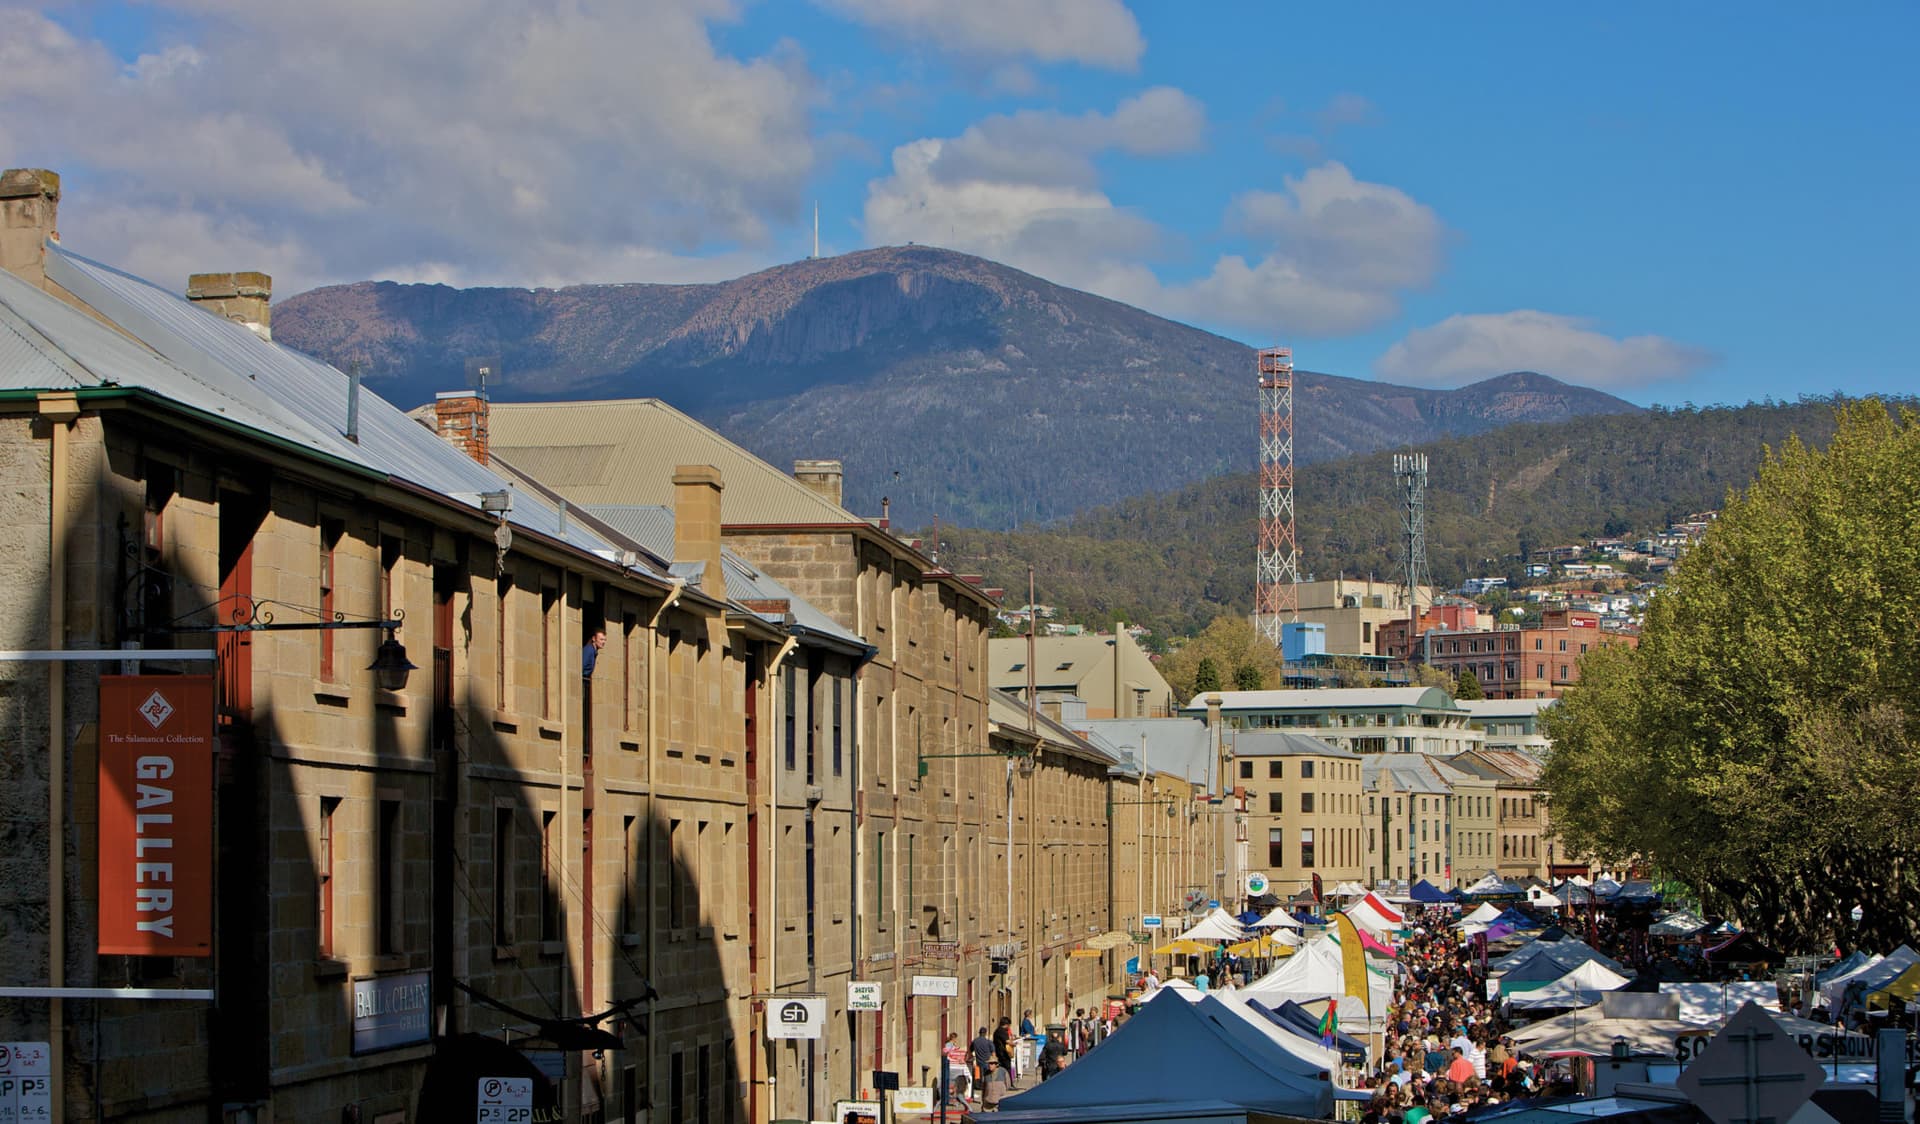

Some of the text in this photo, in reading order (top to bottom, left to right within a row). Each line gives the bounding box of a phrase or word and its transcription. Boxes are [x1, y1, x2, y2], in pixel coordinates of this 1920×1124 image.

[109, 734, 204, 743] The Salamanca Collection
[136, 755, 174, 939] GALLERY
[915, 981, 956, 989] ASPECT
[356, 988, 384, 1018] BALL
[392, 983, 427, 1013] CHAIN
[508, 1109, 530, 1121] 2P
